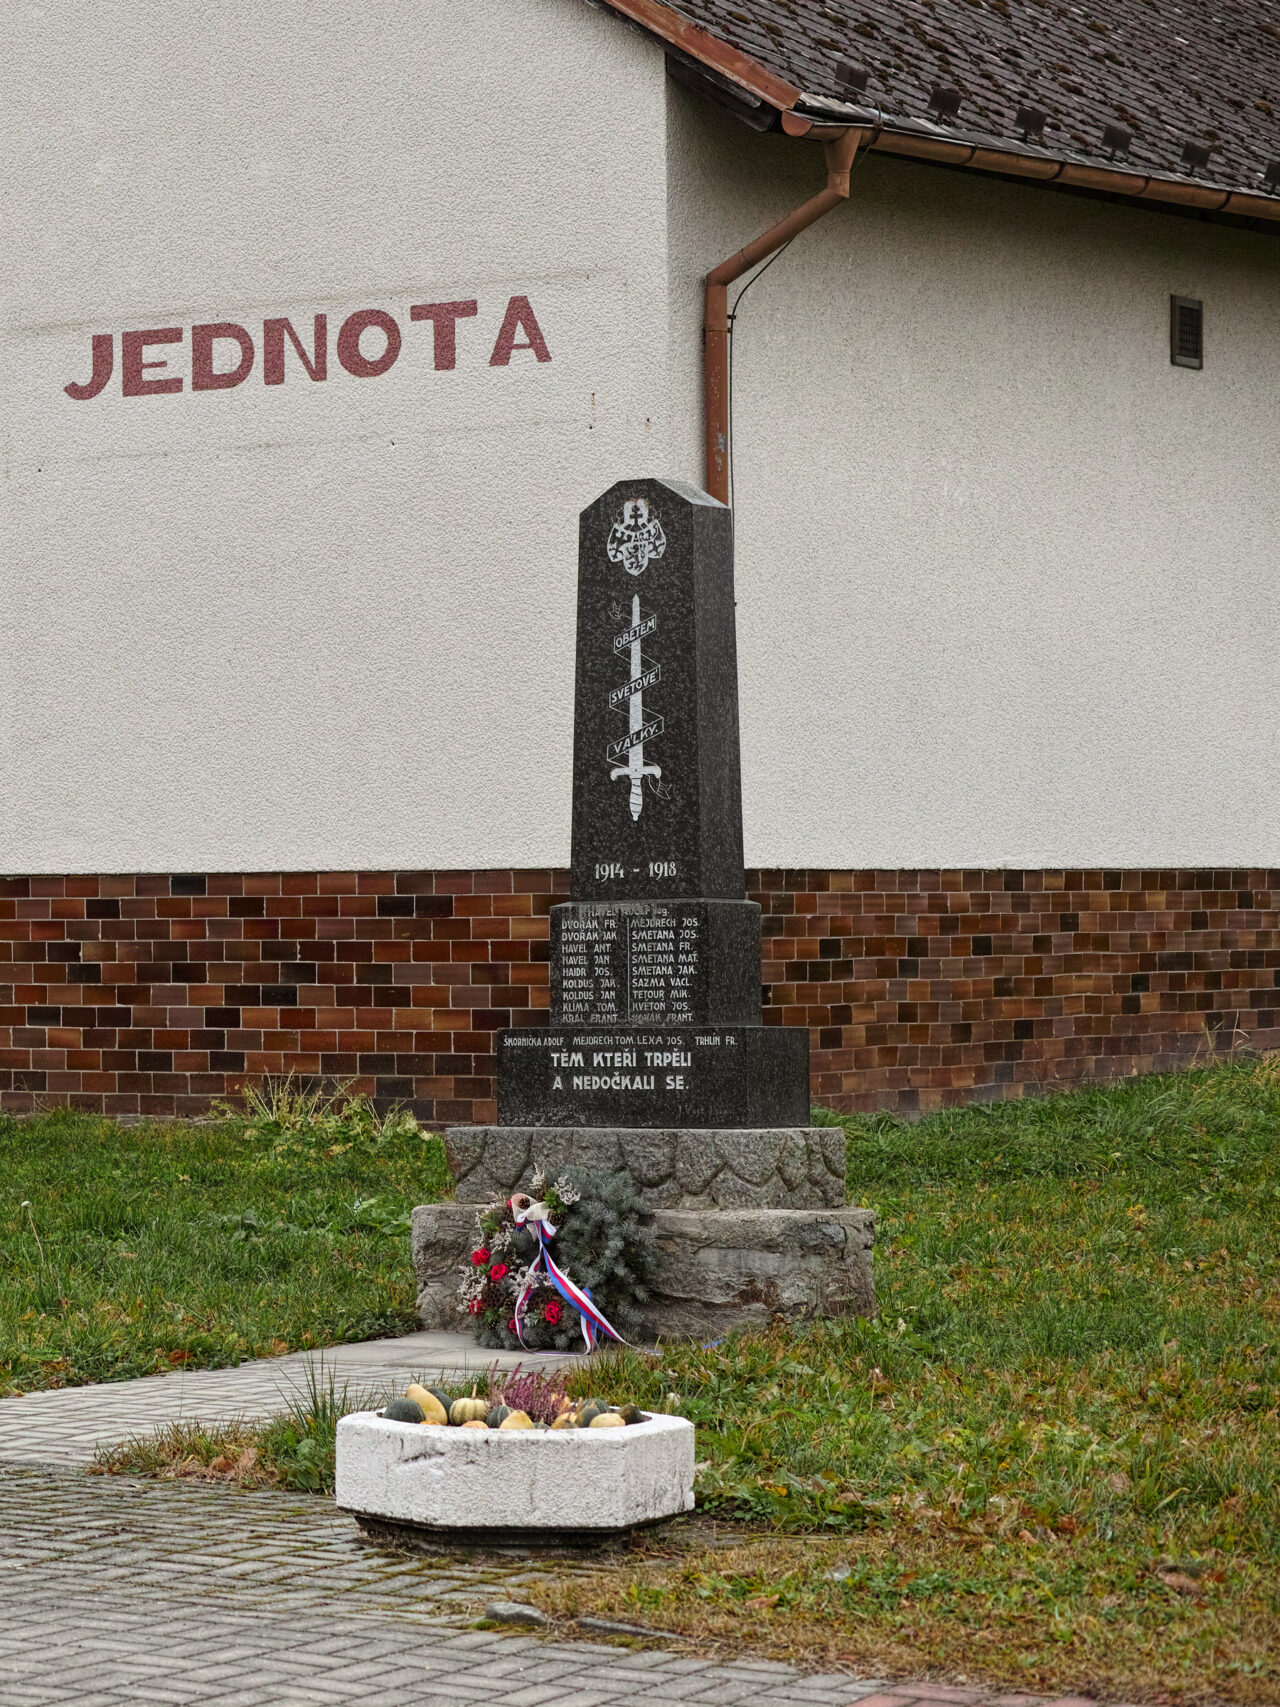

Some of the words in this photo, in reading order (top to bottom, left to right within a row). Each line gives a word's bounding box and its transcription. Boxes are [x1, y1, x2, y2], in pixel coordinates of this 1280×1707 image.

[63, 295, 553, 400] JEDNOTA
[594, 863, 625, 882] 1914
[648, 861, 677, 880] 1918
[604, 919, 619, 929] FR.
[682, 917, 700, 927] JOS.
[561, 929, 599, 942] DVOŘÁK
[631, 930, 675, 940] SMETANA
[679, 929, 699, 939] JOS.
[561, 943, 588, 954] HAVEL
[631, 942, 674, 952] SMETANA
[679, 941, 694, 951] FR.
[562, 955, 589, 966] HAVEL
[594, 955, 610, 965] JAN
[631, 953, 675, 964] SMETANA
[594, 967, 613, 976] JOS.
[632, 965, 673, 976] SMETANA
[677, 965, 698, 975] JAK.
[562, 979, 594, 989] KOLDUS
[600, 979, 620, 988] JAK.
[562, 991, 594, 1001] KOLDUS
[600, 991, 616, 1000] JAN
[632, 989, 665, 999] TETOUR
[669, 989, 691, 999] MIK.
[562, 1000, 590, 1012] KLÍMA
[671, 1001, 691, 1011] JOS.
[543, 1037, 564, 1046] ADOLF
[572, 1036, 614, 1046] MEJDRECH
[637, 1035, 663, 1045] LEXA
[666, 1036, 685, 1046] JOS.
[694, 1033, 721, 1046] TRHLÍN
[551, 1048, 585, 1067] TĚM
[593, 1048, 637, 1067] KTEŘÍ
[645, 1048, 692, 1067] TRPĚLI
[552, 1075, 563, 1090] A
[572, 1071, 655, 1090] NEDOČKALI
[665, 1075, 689, 1090] SE.
